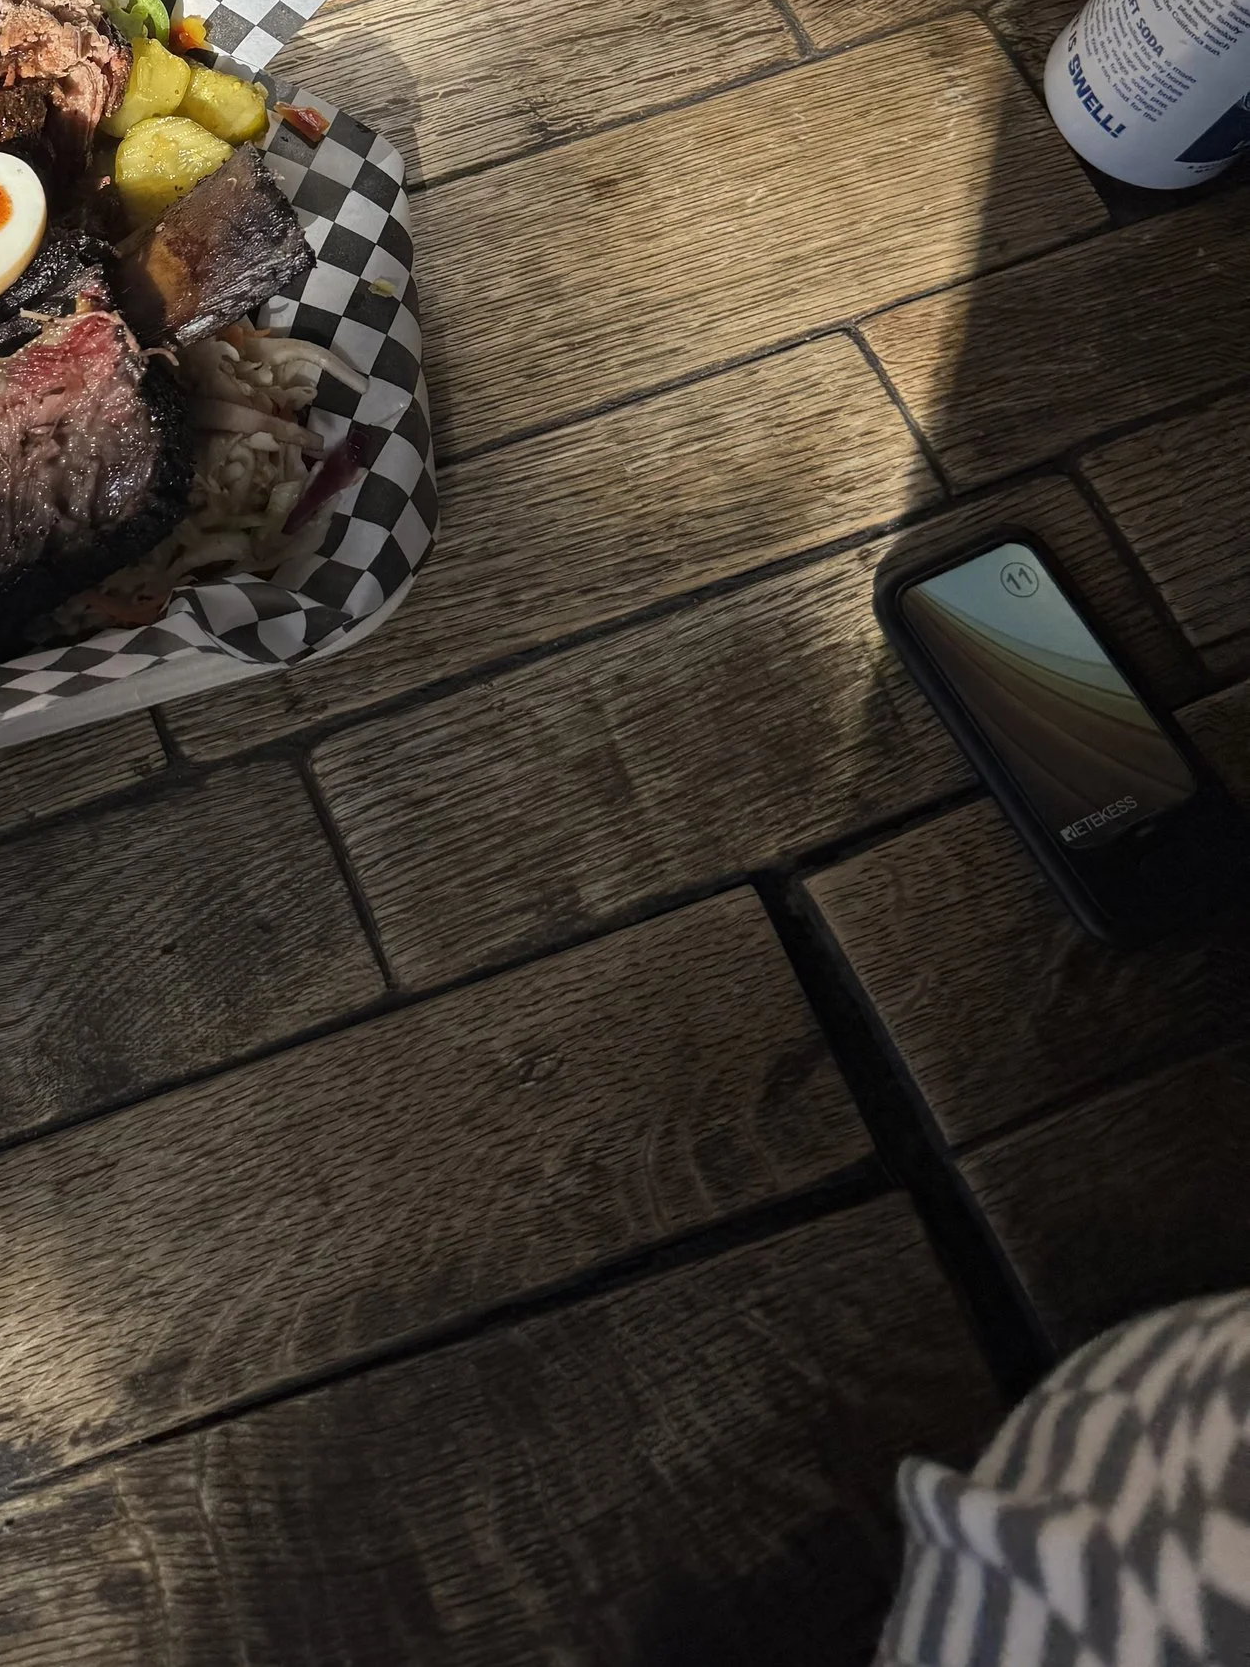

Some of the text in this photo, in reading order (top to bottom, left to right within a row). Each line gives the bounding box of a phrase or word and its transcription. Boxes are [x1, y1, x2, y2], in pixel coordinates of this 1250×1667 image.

[1172, 10, 1203, 45] California
[1204, 30, 1230, 50] beach
[1135, 17, 1164, 57] SODA
[1172, 66, 1196, 83] made
[1140, 45, 1151, 60] this
[1151, 61, 1166, 72] city
[1068, 53, 1126, 137] SWELL!
[1120, 77, 1132, 92] San
[1134, 94, 1162, 115] Diego's
[1131, 77, 1148, 95] soda
[1140, 74, 1154, 88] and
[1158, 89, 1177, 102] bold
[1151, 72, 1182, 96] batches
[1112, 83, 1129, 102] head
[1130, 102, 1141, 111] for
[1143, 112, 1156, 121] the
[1007, 567, 1032, 590] 11
